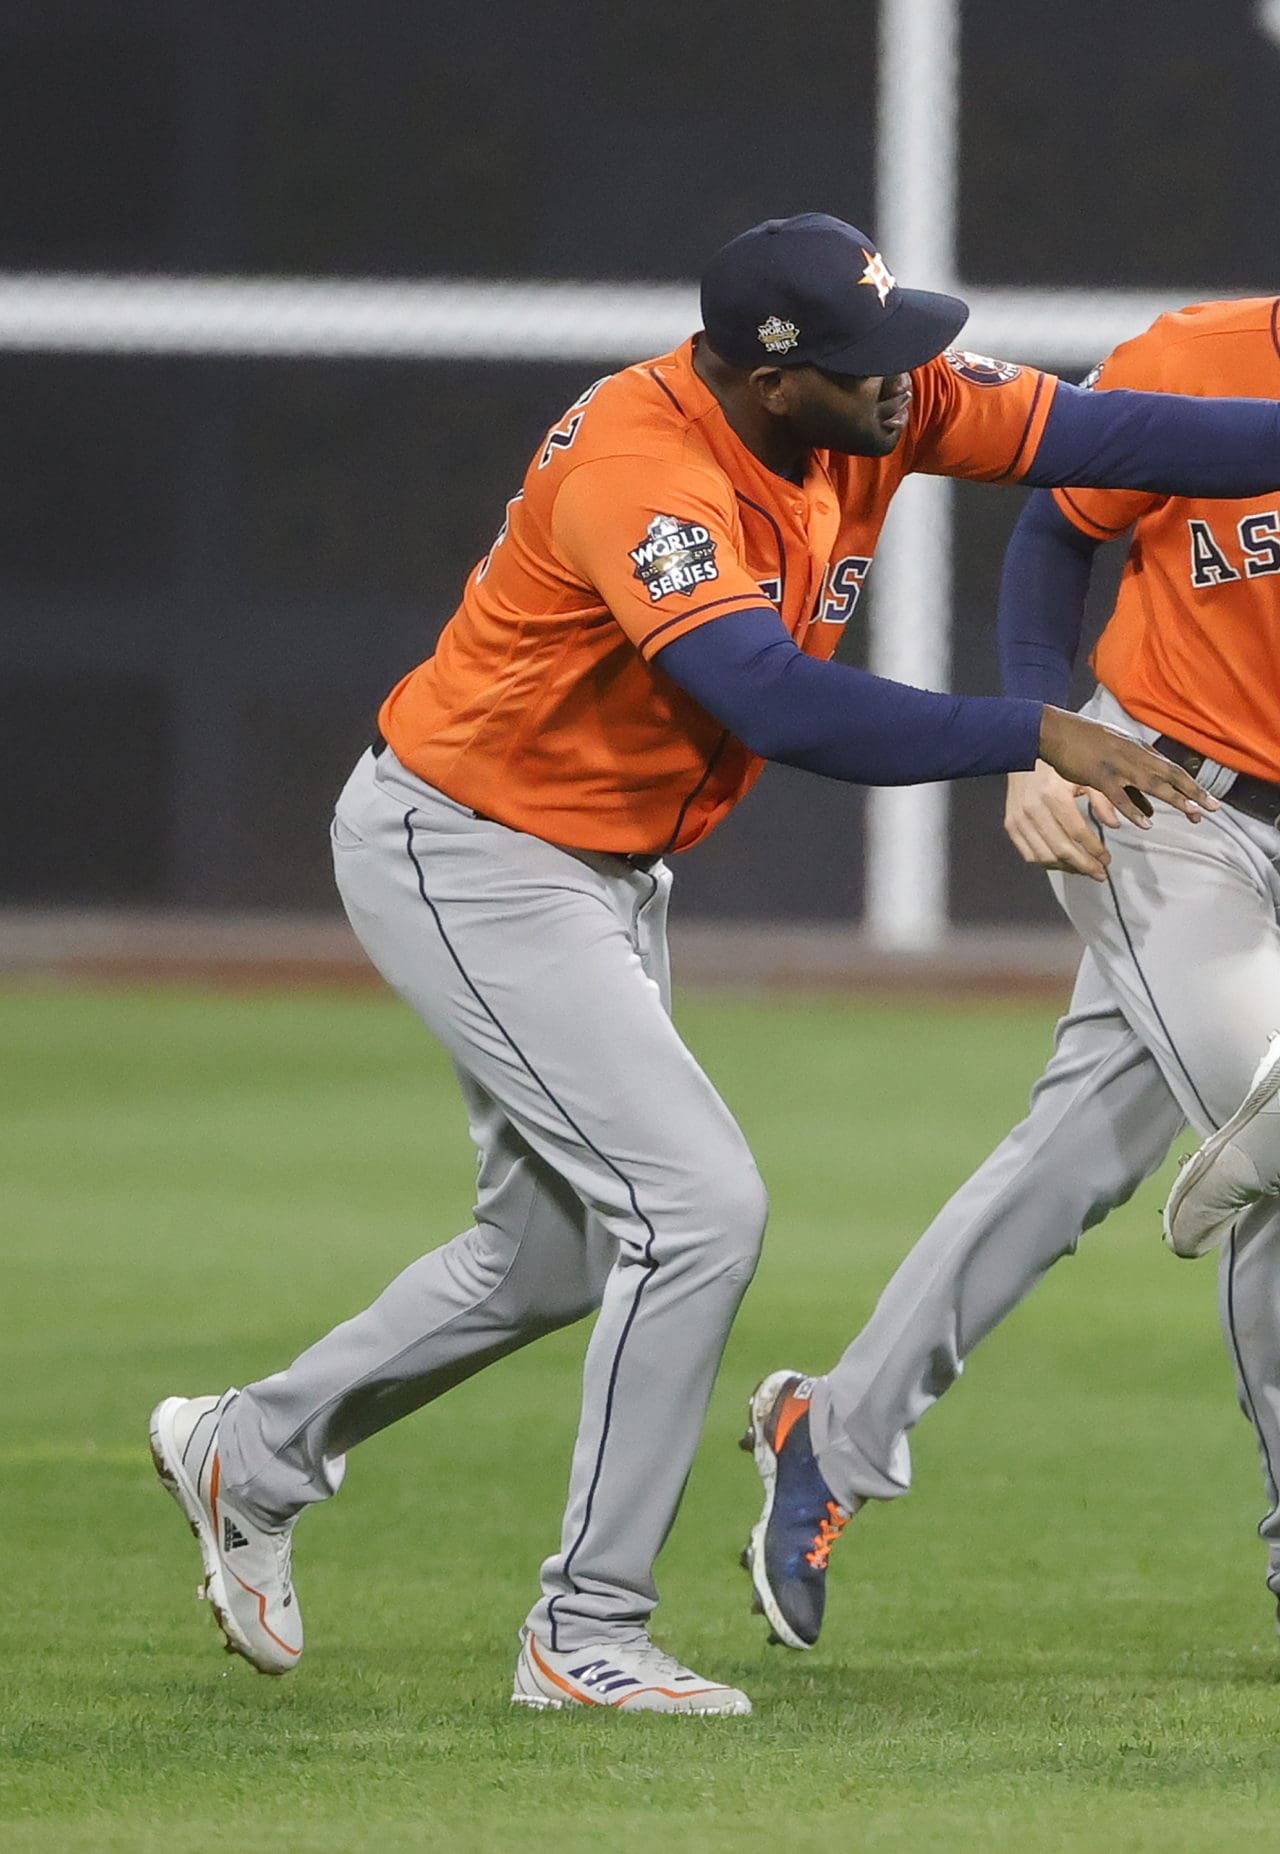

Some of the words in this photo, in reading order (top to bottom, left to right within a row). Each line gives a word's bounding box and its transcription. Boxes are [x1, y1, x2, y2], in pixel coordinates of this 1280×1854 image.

[758, 322, 795, 338] WORLD
[765, 338, 799, 353] SERIES
[630, 526, 710, 568] WORLD
[648, 560, 718, 601] SERIES
